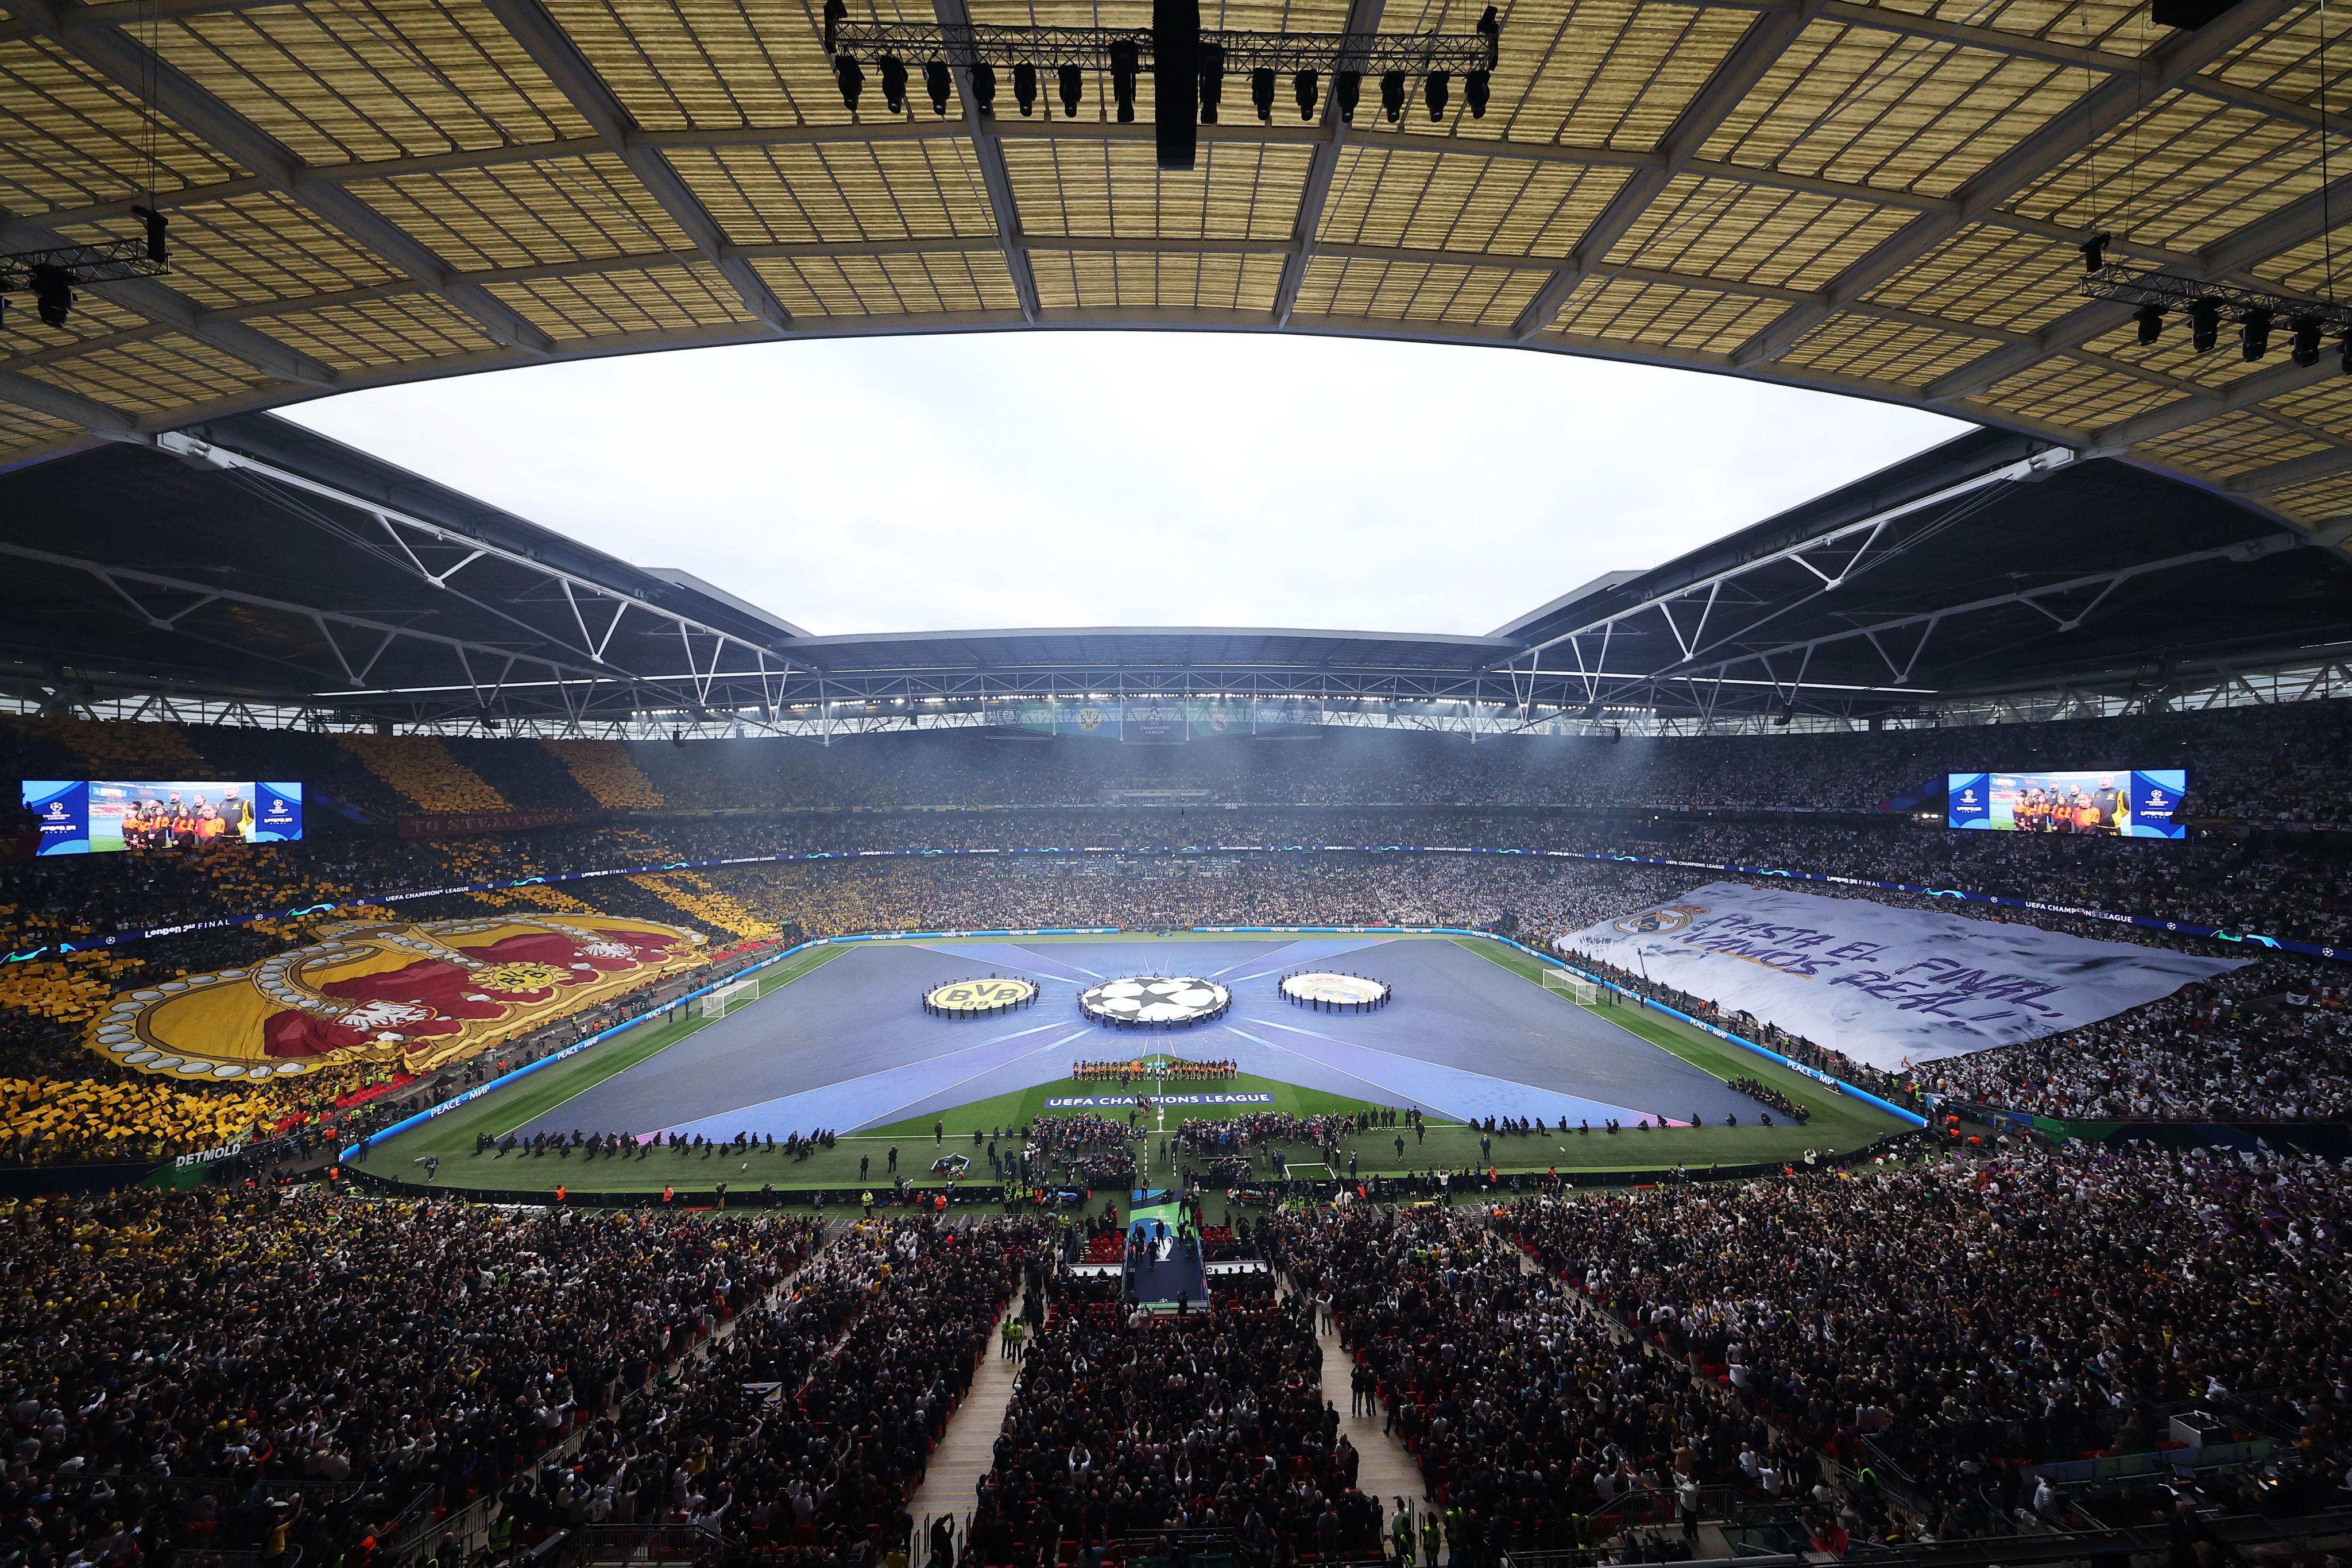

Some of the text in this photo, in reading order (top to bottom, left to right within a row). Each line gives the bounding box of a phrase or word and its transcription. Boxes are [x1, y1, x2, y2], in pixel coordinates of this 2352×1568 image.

[411, 820, 439, 833] TO
[448, 816, 516, 831] STEAL
[445, 886, 470, 894] LEAGUE
[2025, 901, 2046, 909] UEFA
[183, 923, 195, 932] 24
[198, 919, 230, 930] FINAL
[1702, 913, 1835, 950] HASTA
[1825, 942, 1894, 962] EL
[945, 984, 1019, 1001] BVB
[1636, 996, 1647, 1004] МР
[646, 1008, 662, 1020] PEACE
[1690, 1018, 1708, 1031] PEACE
[1712, 1028, 1727, 1039] МИР
[558, 1045, 579, 1060] PEACE
[584, 1036, 599, 1048] МИР
[1787, 1060, 1812, 1077] PEACE
[431, 1097, 461, 1118] PEACE
[469, 1085, 490, 1100] МИР
[1049, 1097, 1094, 1106] UEFA
[1205, 1094, 1271, 1103] LEAGUE
[175, 1143, 241, 1168] DETMOLD
